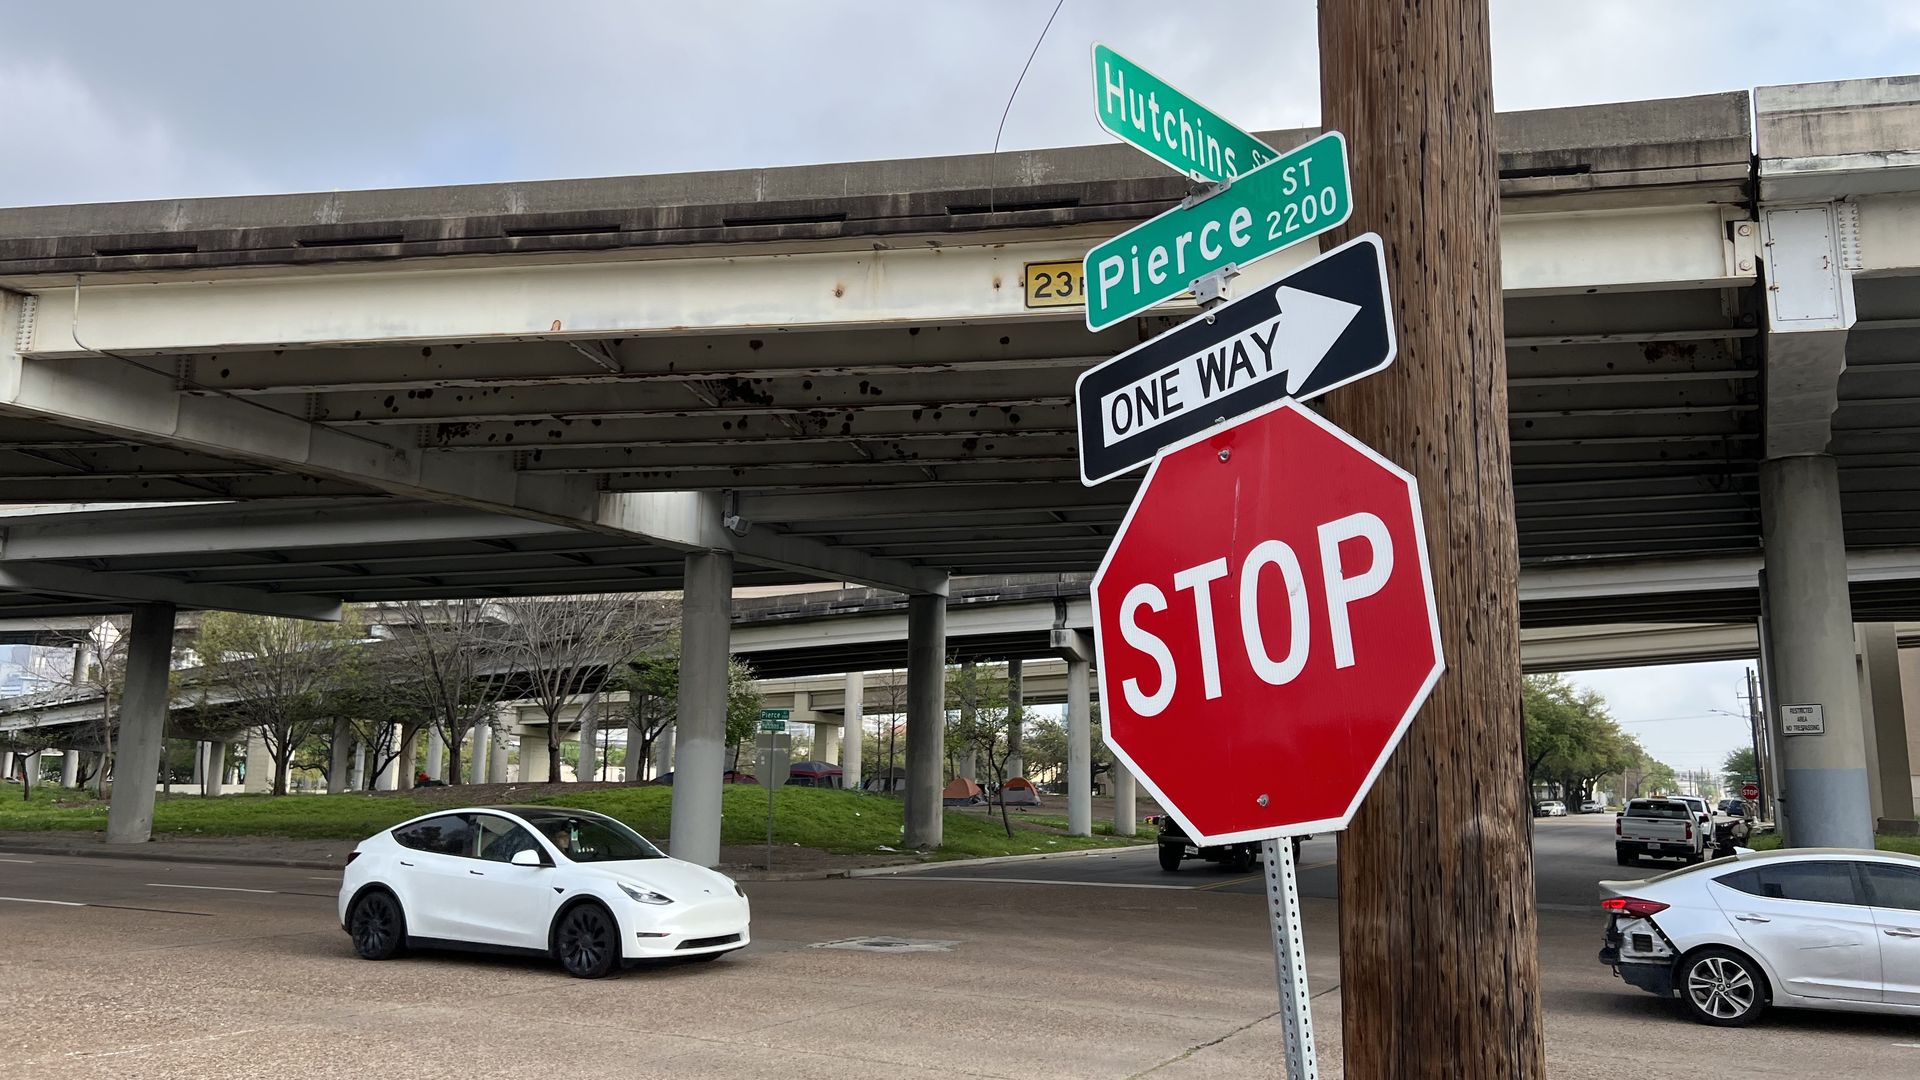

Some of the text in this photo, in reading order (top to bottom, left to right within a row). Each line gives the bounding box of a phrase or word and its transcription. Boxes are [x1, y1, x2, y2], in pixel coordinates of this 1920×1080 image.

[1104, 60, 1239, 179] Hutchins
[1266, 186, 1338, 241] 2200
[1282, 157, 1313, 197] ST
[1098, 206, 1253, 310] Pierce
[1111, 321, 1281, 436] ONE WAY
[1119, 511, 1395, 718] STOP
[761, 711, 781, 719] Pierce
